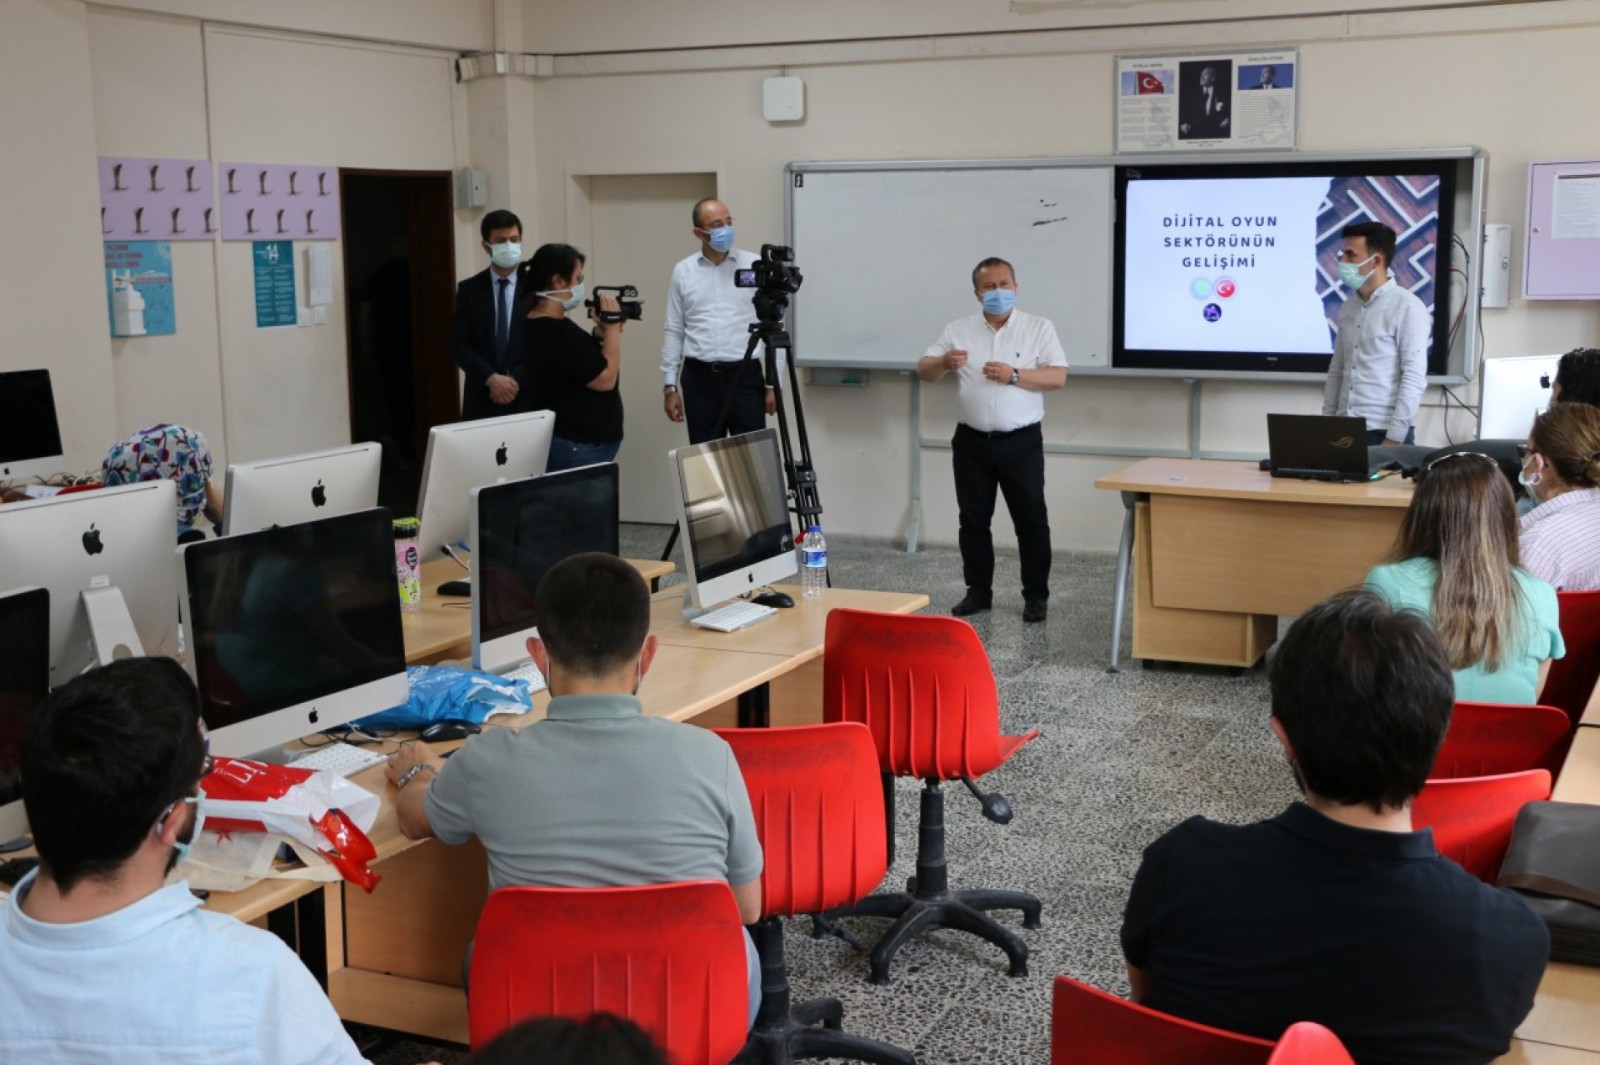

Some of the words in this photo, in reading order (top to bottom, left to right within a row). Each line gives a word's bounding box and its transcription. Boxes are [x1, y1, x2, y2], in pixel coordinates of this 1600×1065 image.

[1164, 213, 1224, 227] DİJİTAL
[1231, 216, 1277, 227] OYUN
[1163, 234, 1276, 247] SEKTÖRÜNÜN
[266, 243, 280, 261] 14
[1182, 254, 1256, 270] GELİŞİMİ
